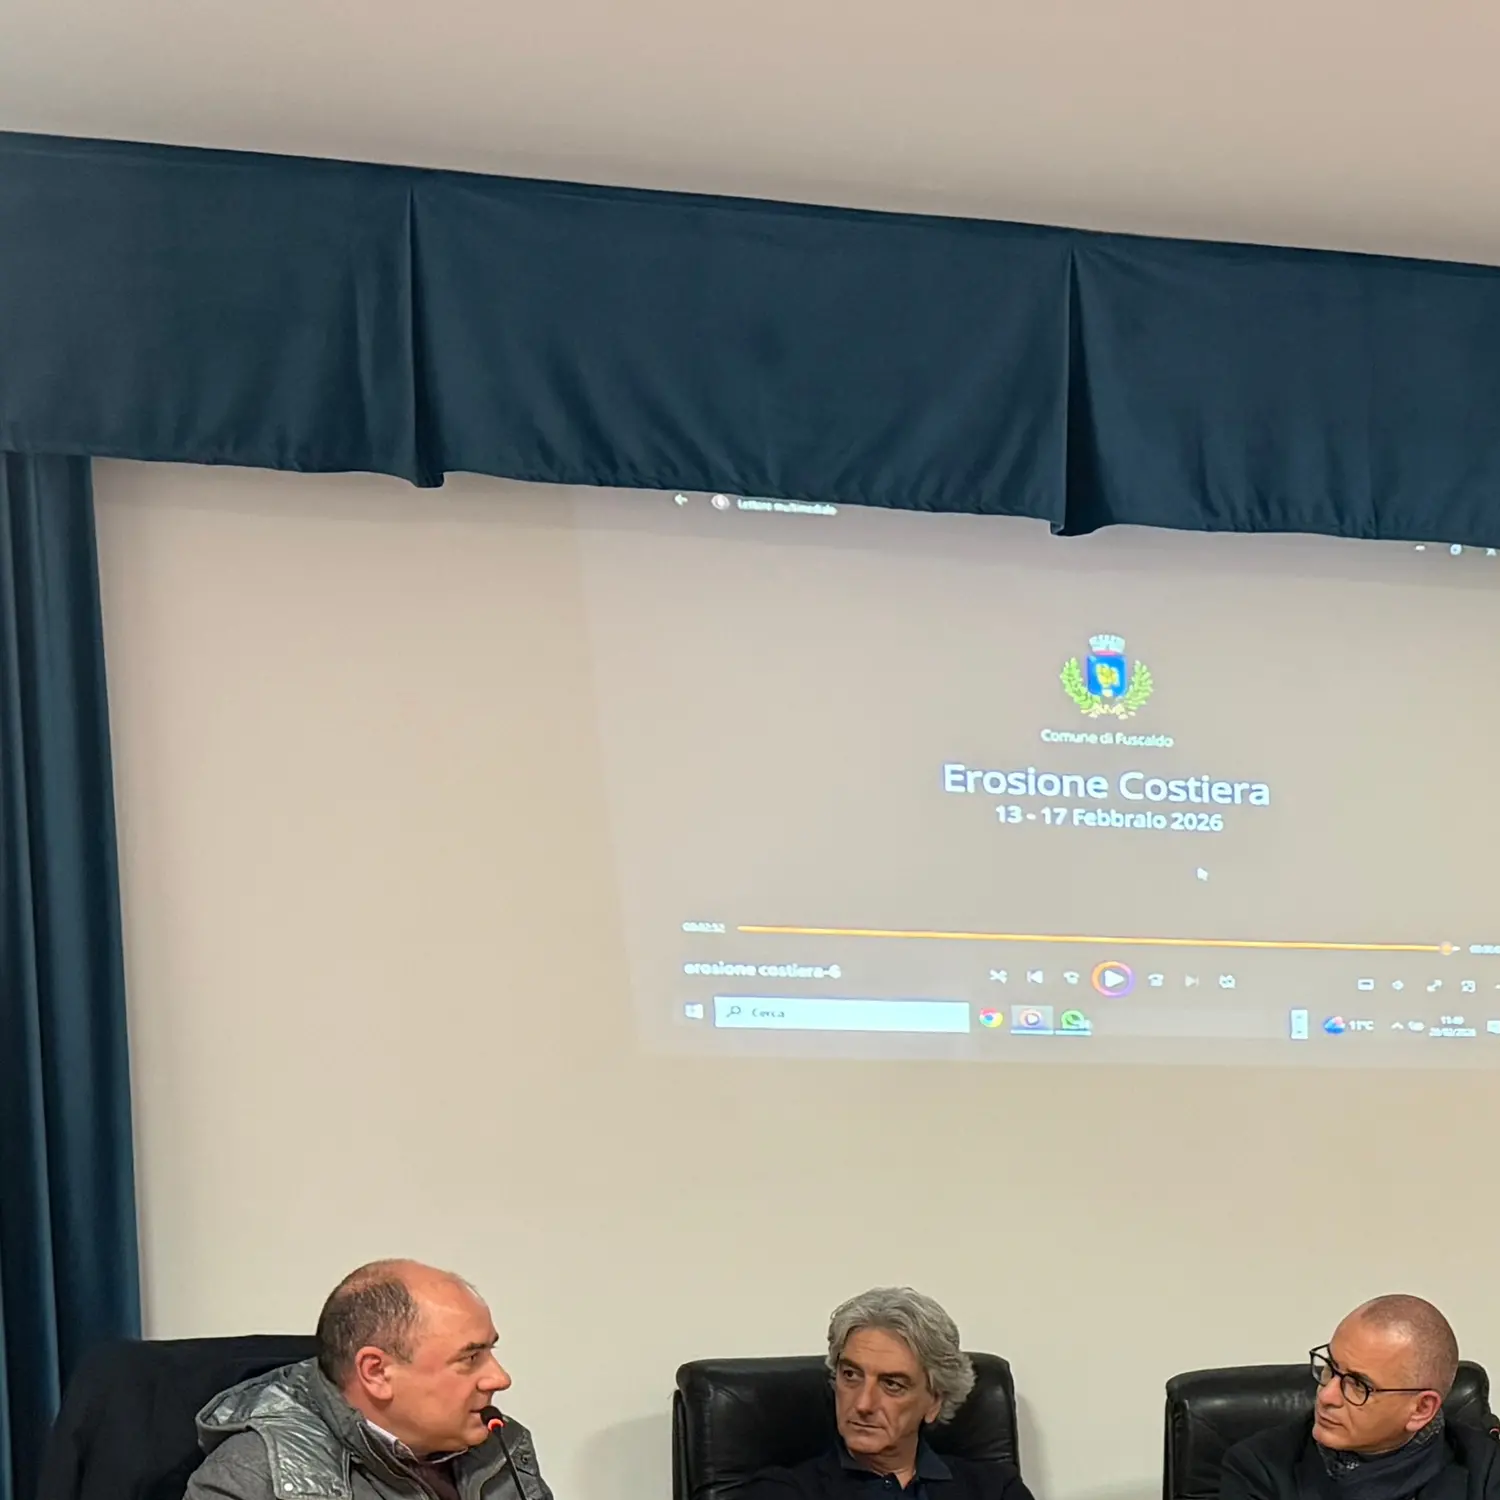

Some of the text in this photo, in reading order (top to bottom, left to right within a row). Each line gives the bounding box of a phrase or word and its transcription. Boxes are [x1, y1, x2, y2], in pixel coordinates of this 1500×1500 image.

[1040, 729, 1174, 747] Comune di Fuscaldo
[943, 763, 1271, 806] Erosione Costiera
[995, 805, 1023, 824] 13
[1042, 807, 1068, 825] 17
[1072, 808, 1168, 830] Febbraio
[1170, 812, 1224, 832] 2026
[683, 961, 757, 976] erosione
[751, 1007, 785, 1018] Cerca
